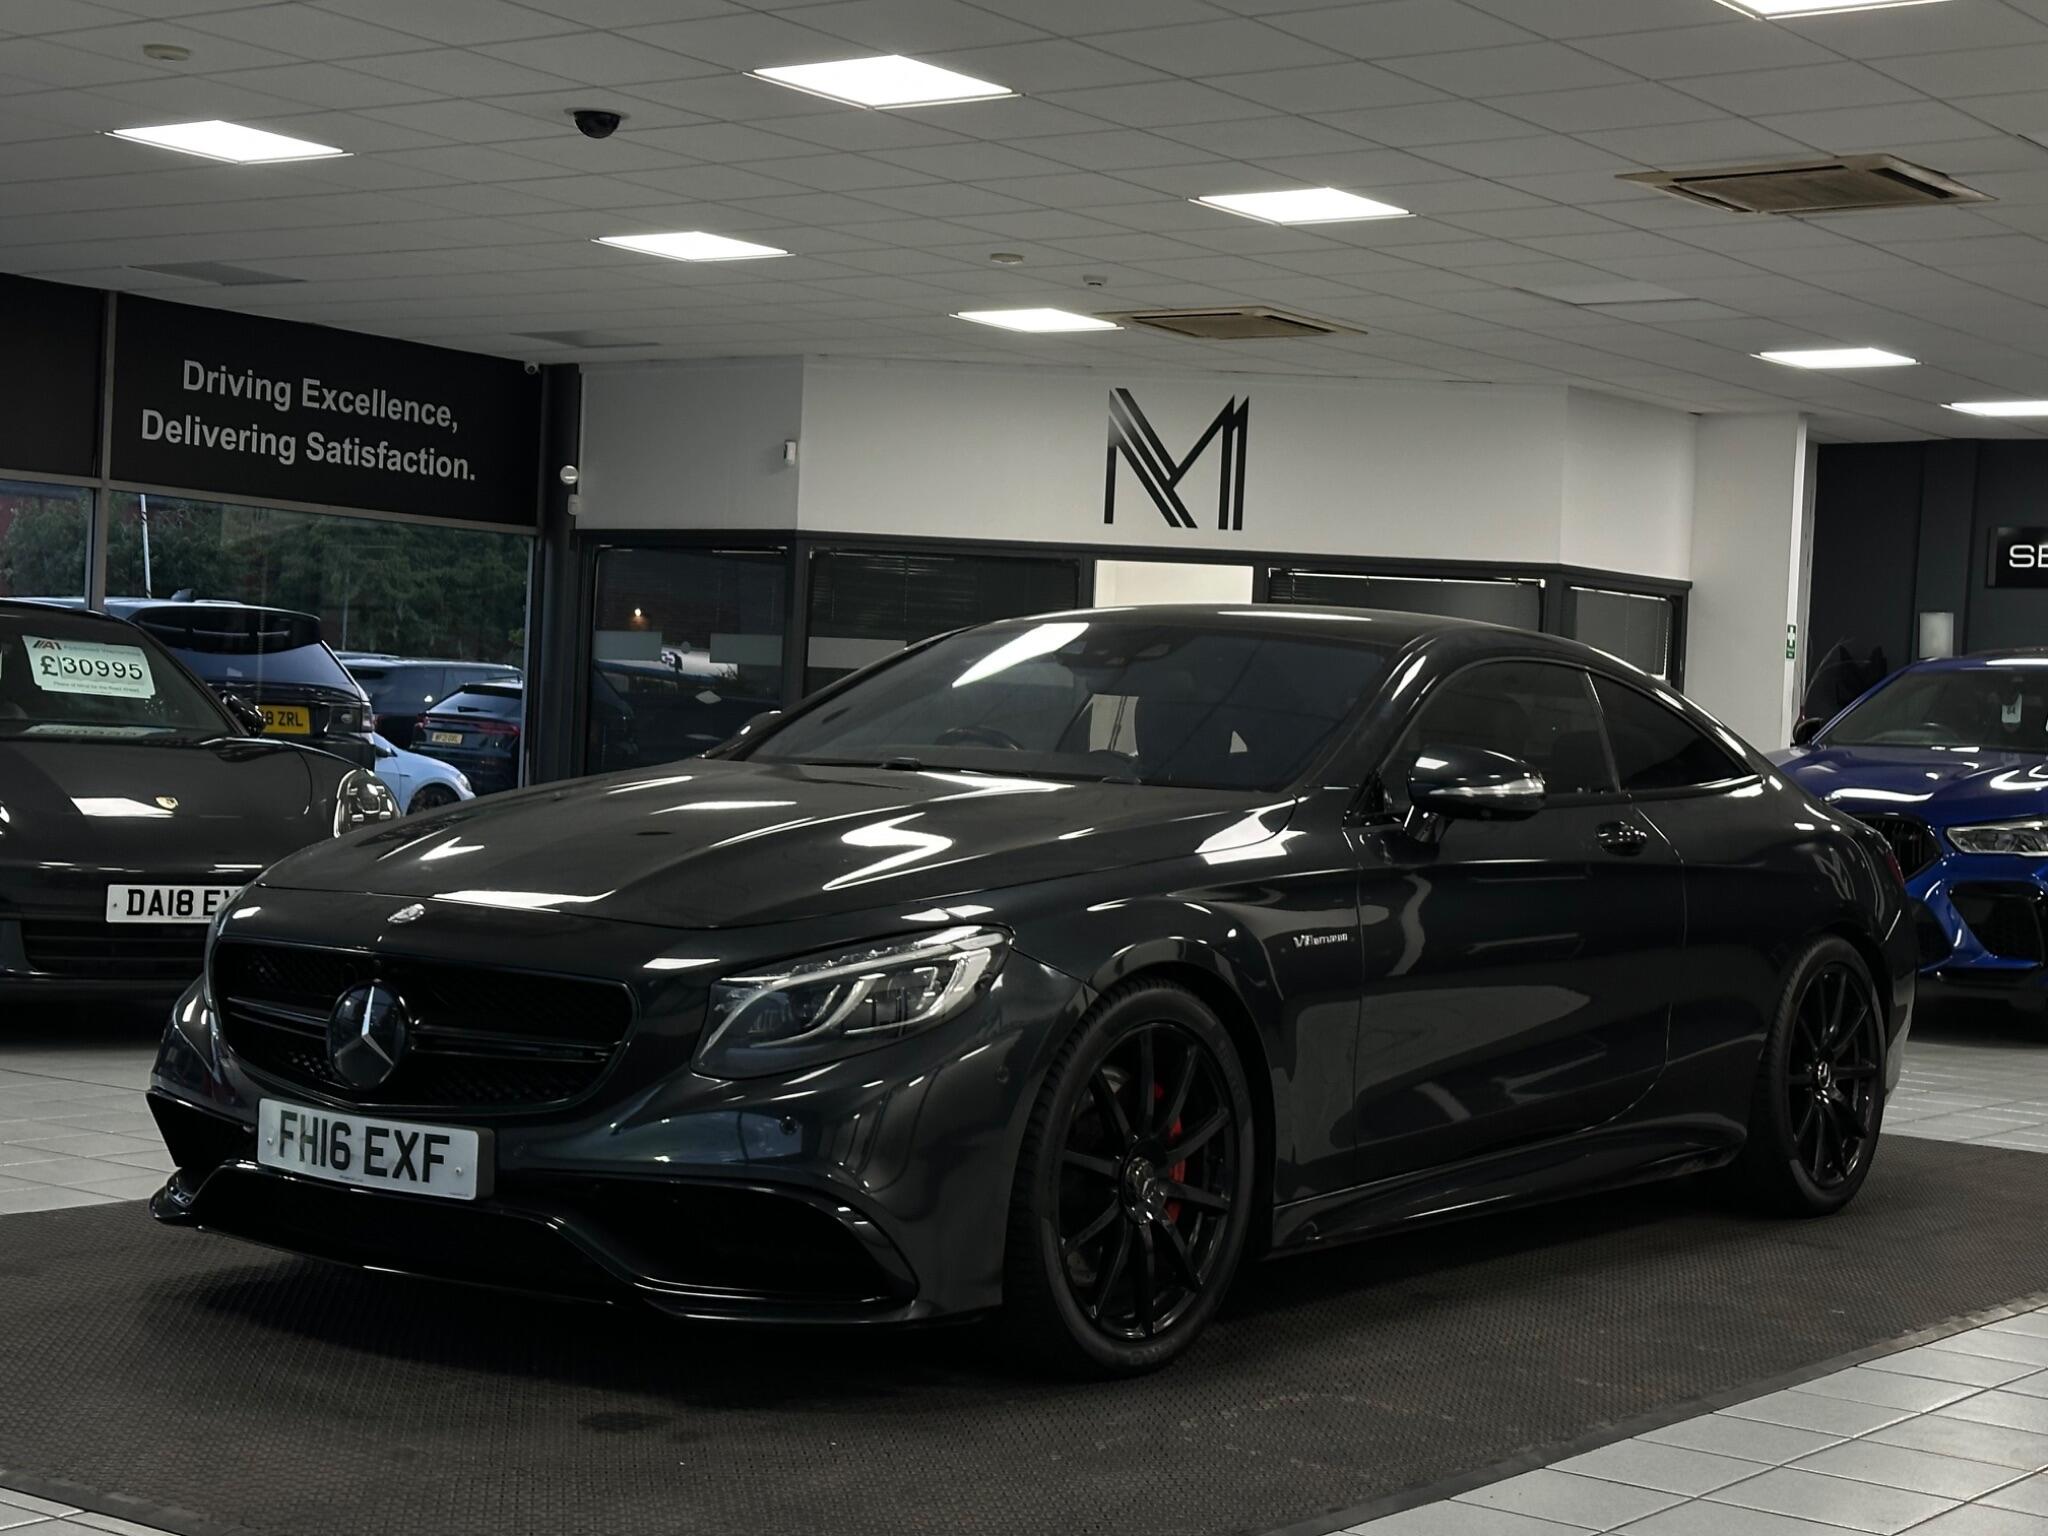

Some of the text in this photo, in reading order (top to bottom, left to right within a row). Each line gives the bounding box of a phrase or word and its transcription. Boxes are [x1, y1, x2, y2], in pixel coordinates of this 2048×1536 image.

[183, 359, 458, 434] Driving Excellence,
[141, 408, 476, 481] Delivering Satisfaction.
[278, 711, 304, 727] ZRL
[126, 889, 194, 916] DA18
[279, 1109, 450, 1183] FH16 EXF
